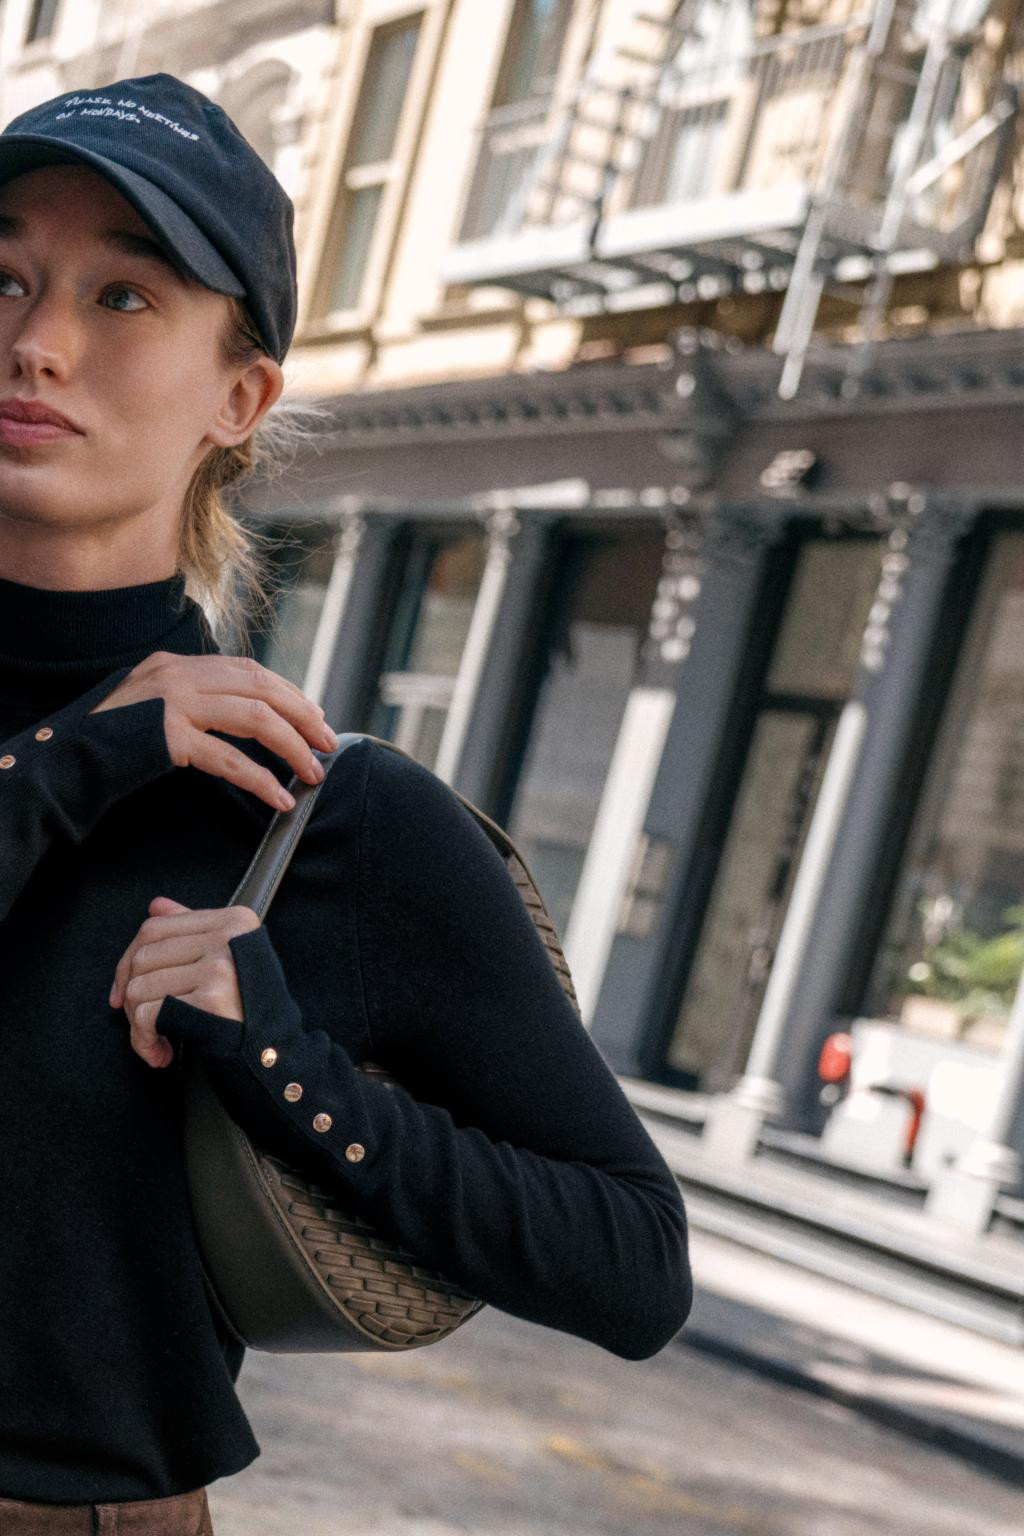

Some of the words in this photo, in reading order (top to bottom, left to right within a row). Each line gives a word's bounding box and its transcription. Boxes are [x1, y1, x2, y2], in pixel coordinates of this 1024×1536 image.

[56, 109, 76, 120] ON
[118, 99, 136, 108] NO
[138, 105, 200, 141] MEETINGS
